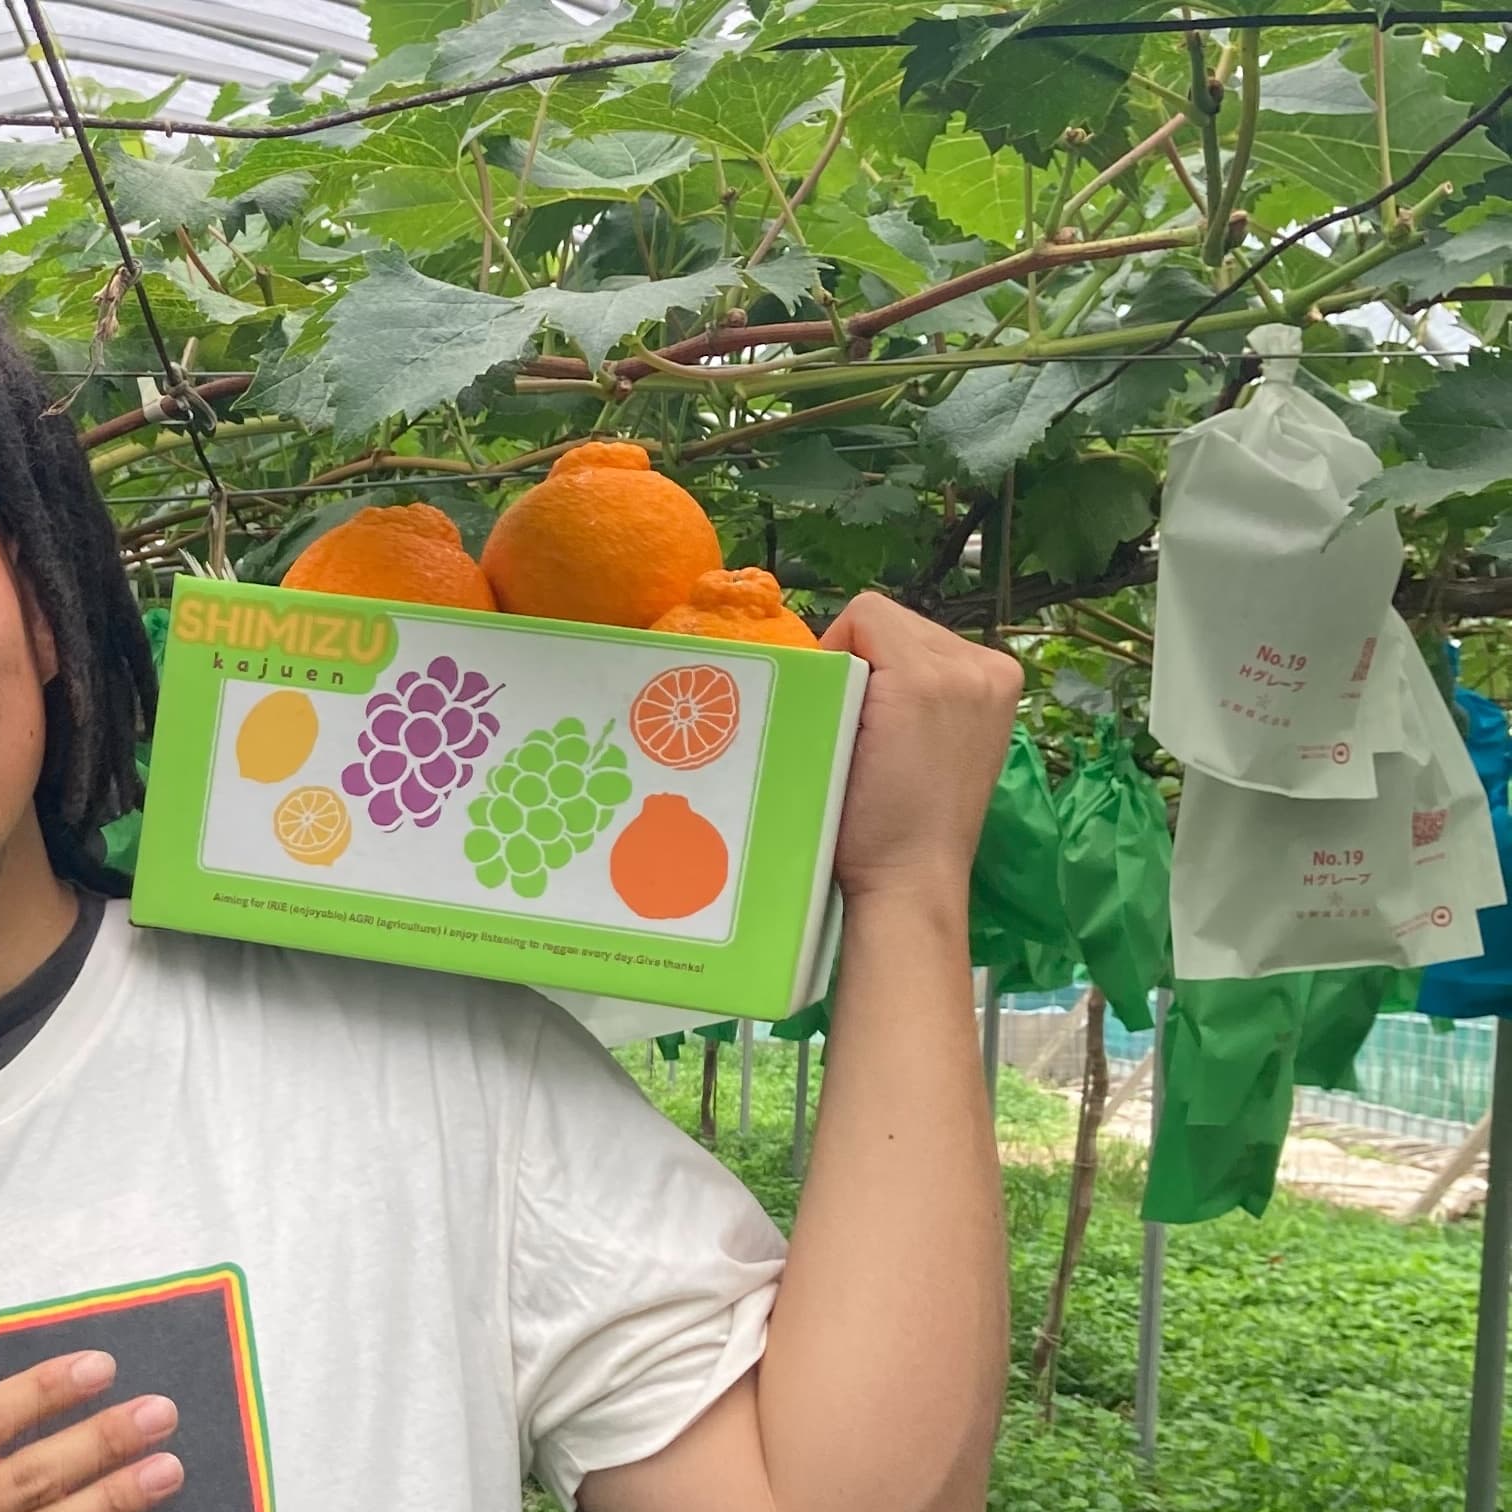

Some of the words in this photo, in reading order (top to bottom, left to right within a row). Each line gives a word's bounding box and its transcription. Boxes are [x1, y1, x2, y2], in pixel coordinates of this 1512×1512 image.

[175, 598, 386, 664] SHIMIZU
[213, 652, 344, 685] kajuen
[1256, 645, 1307, 671] No.19
[1313, 850, 1364, 866] No.19
[212, 892, 249, 908] Aiming
[251, 897, 265, 909] for
[267, 900, 287, 912] IRIE
[290, 903, 347, 922] (enjoyable)
[349, 913, 374, 925] AGRI
[377, 917, 441, 936] (agriculture)
[449, 929, 478, 943] enjoy
[481, 932, 526, 950] listening
[529, 939, 539, 949] to
[543, 942, 579, 956] reggae
[582, 948, 612, 962] every
[664, 959, 705, 973] thanks!
